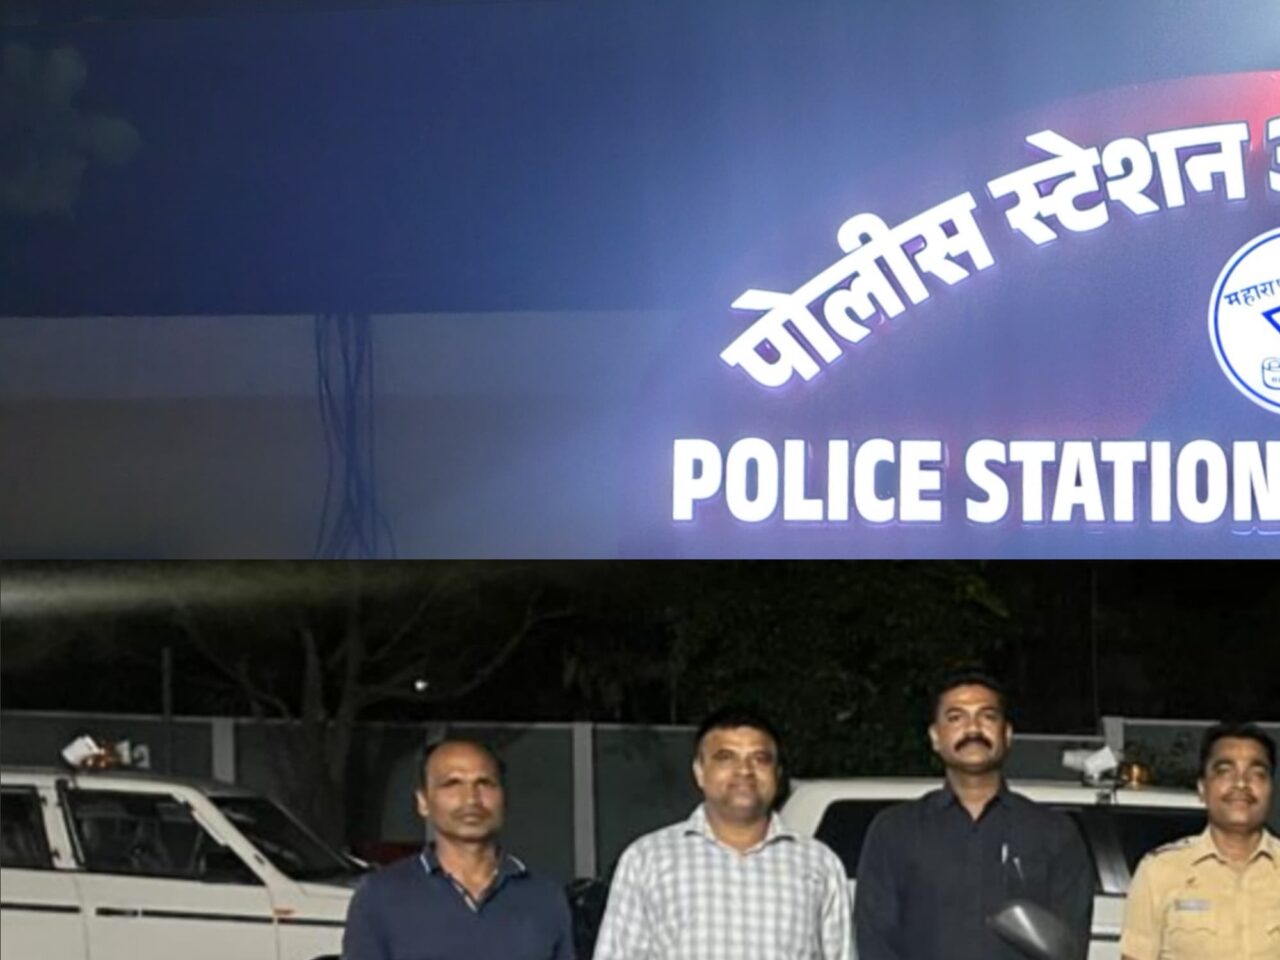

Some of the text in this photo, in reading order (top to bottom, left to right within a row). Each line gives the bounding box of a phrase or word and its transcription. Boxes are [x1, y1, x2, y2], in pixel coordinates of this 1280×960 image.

[720, 192, 996, 387] पोलीस
[987, 122, 1249, 246] स्टेशन
[672, 437, 943, 523] POLICE
